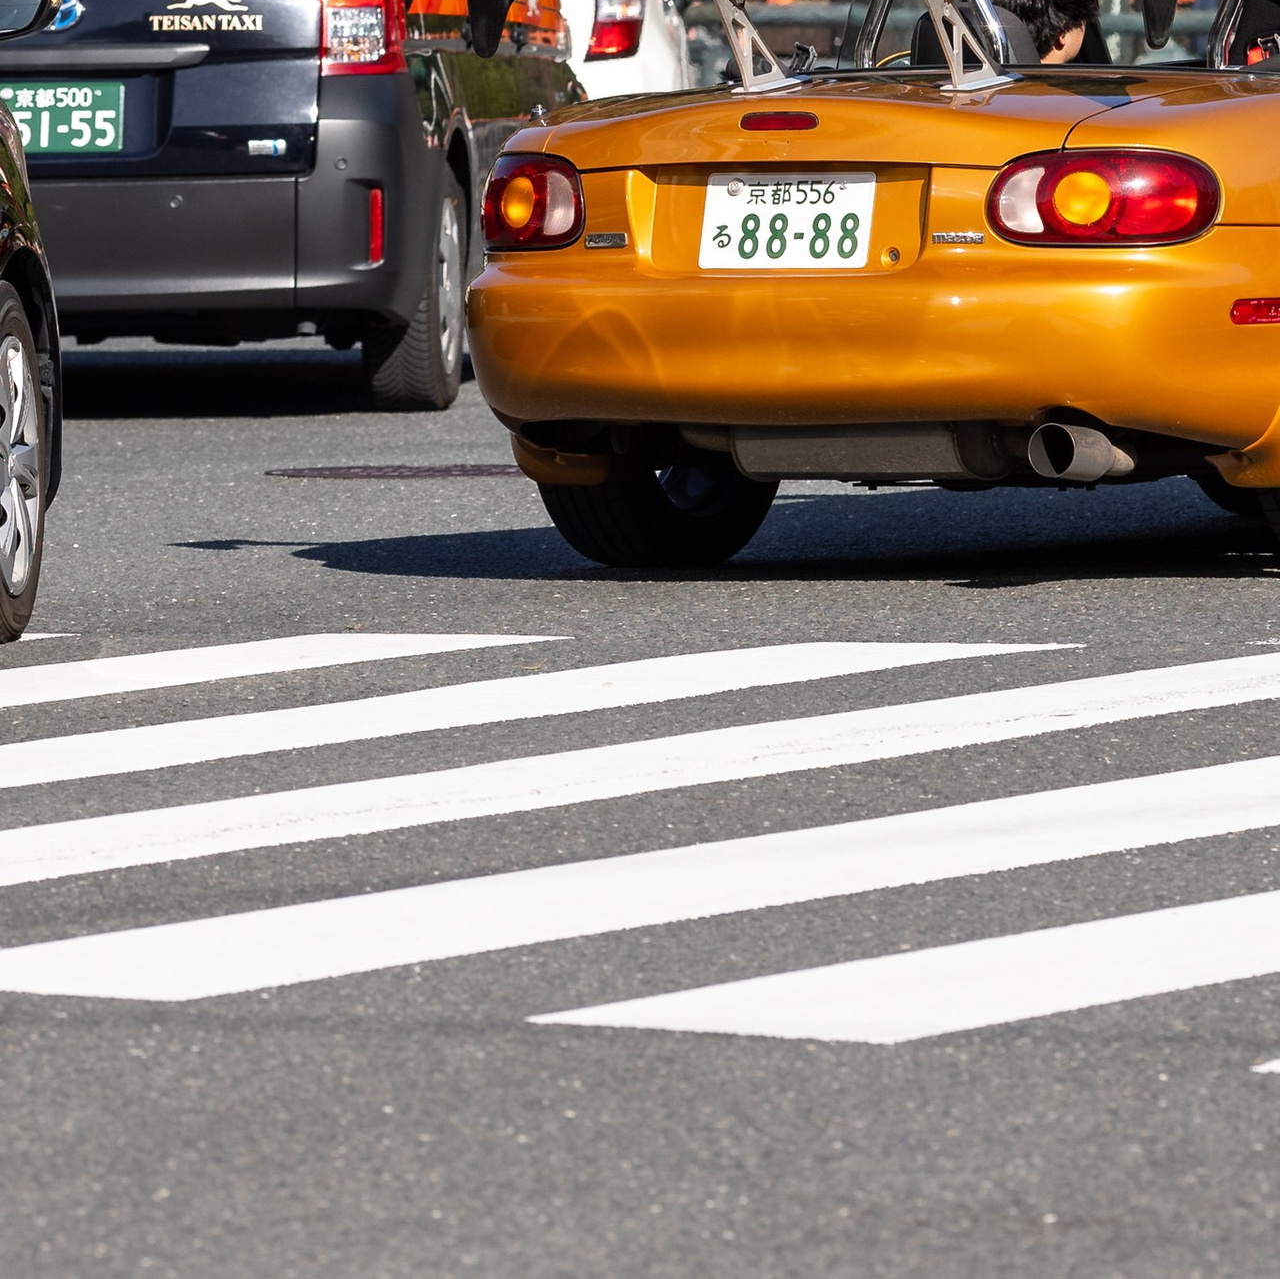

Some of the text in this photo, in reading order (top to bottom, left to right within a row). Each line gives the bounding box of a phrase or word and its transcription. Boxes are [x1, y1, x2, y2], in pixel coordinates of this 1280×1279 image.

[149, 14, 263, 31] TEISAN TAXI
[712, 213, 860, 259] る 88-88
[932, 232, 985, 244] mazda
